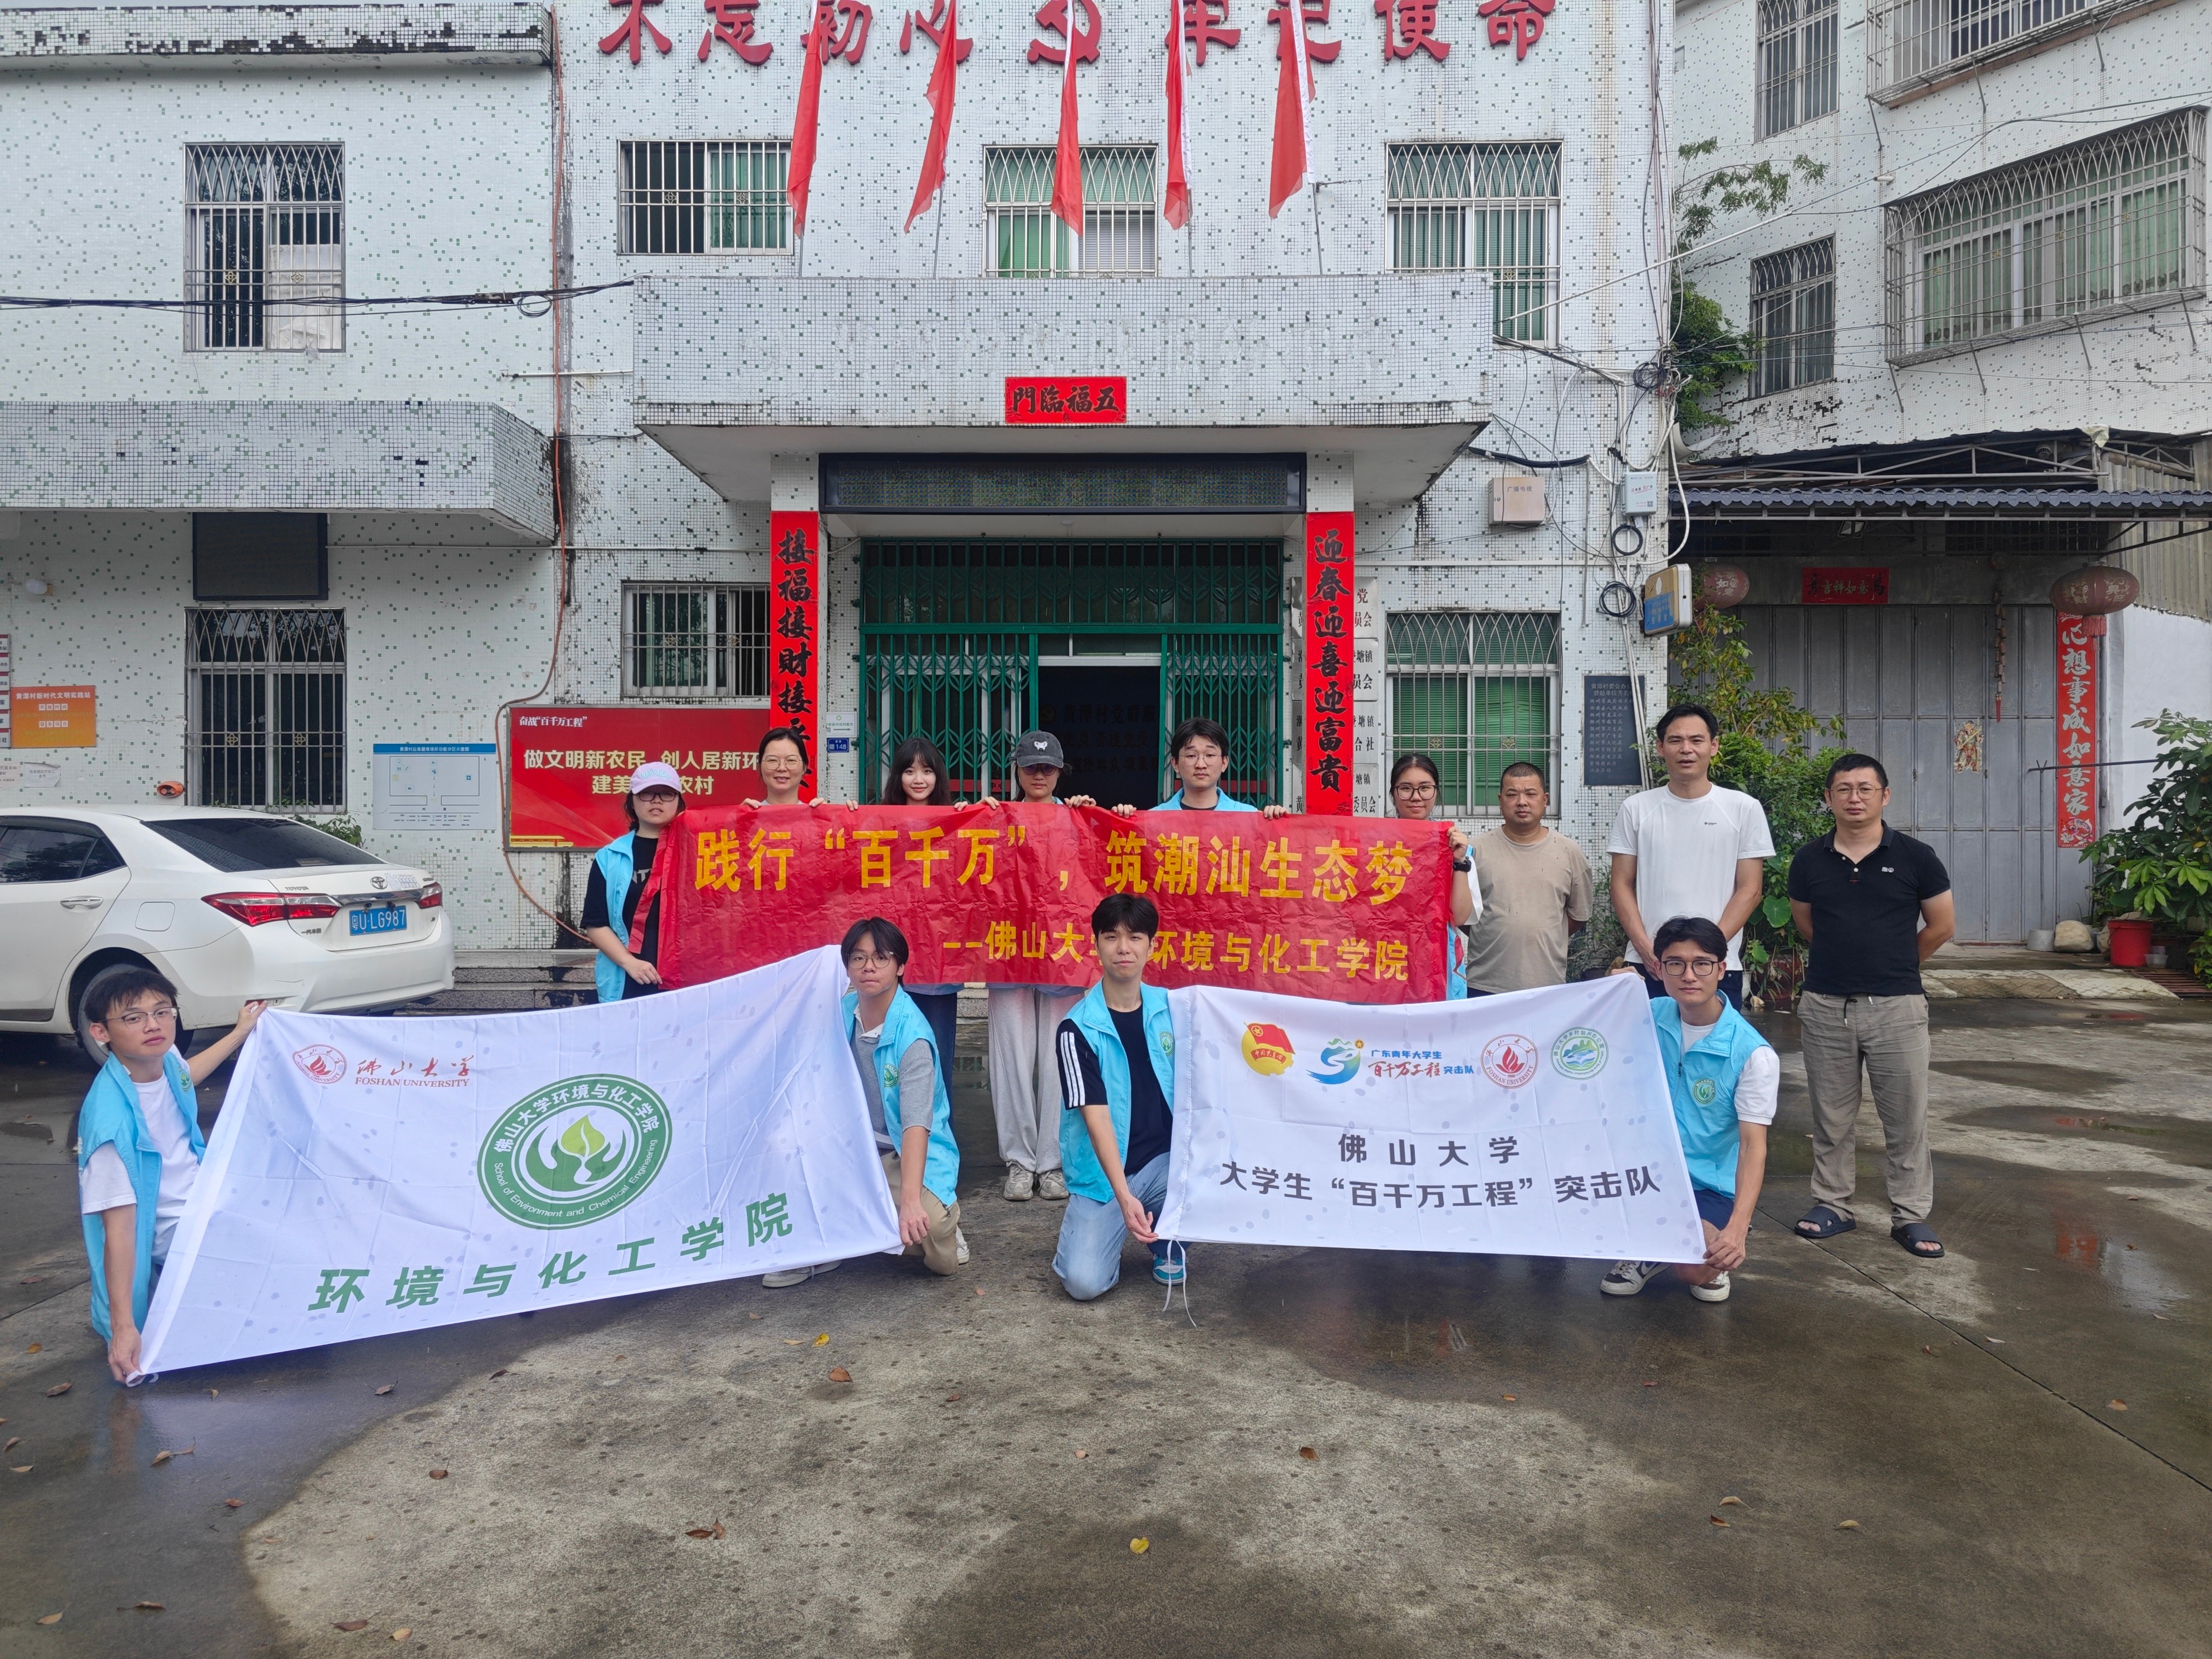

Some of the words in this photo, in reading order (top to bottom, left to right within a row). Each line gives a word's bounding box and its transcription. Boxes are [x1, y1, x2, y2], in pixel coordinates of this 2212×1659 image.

[1309, 529, 1350, 792] 迎春迎喜迎富貴
[524, 750, 646, 770] 做文明新农民
[1371, 1049, 1442, 1059] 广东青年大学生
[1444, 1065, 1474, 1075] 突击队
[355, 1077, 400, 1086] FOSHAN
[403, 1078, 470, 1088] UNIVERSITY
[493, 1083, 660, 1153] 佛山大学环境与化工学院
[1338, 1133, 1520, 1166] 佛山大学
[494, 1162, 508, 1186] School
[503, 1187, 514, 1196] of
[510, 1194, 563, 1217] Environment
[566, 1206, 584, 1217] and
[589, 1184, 630, 1211] Chemical
[629, 1139, 658, 1184] Engineering
[308, 1192, 794, 1313] 环境与化工学院
